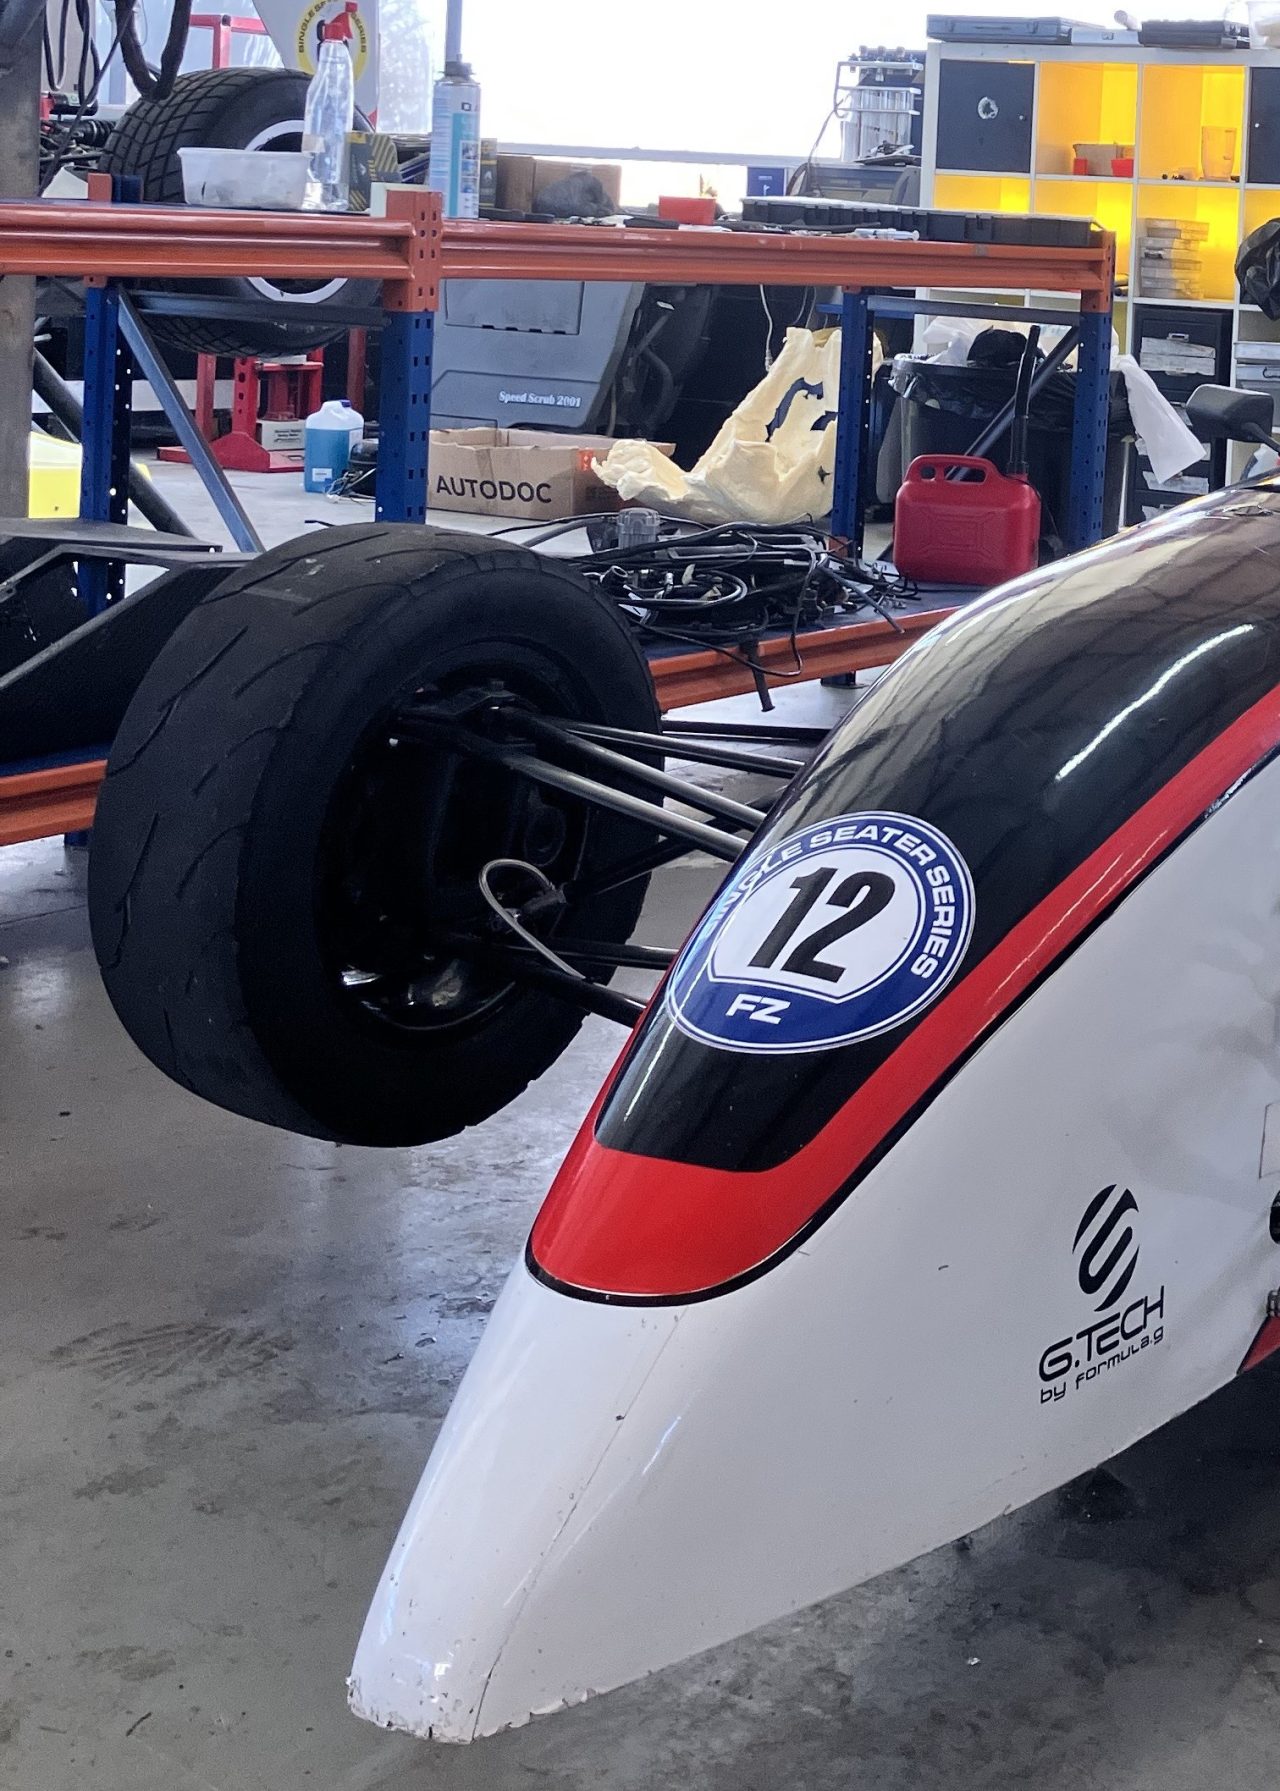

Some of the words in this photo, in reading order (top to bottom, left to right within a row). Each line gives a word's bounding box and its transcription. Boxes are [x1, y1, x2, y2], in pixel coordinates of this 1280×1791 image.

[499, 391, 528, 404] Speed
[528, 392, 556, 405] Scrub
[556, 394, 581, 408] 2001
[436, 474, 552, 504] AUTODOC
[810, 824, 937, 868] SEATER
[910, 865, 956, 979] SERIES
[747, 867, 896, 984] 12
[725, 993, 791, 1025] FZ
[1039, 1284, 1164, 1382] G.TECH
[1040, 1382, 1066, 1404] by
